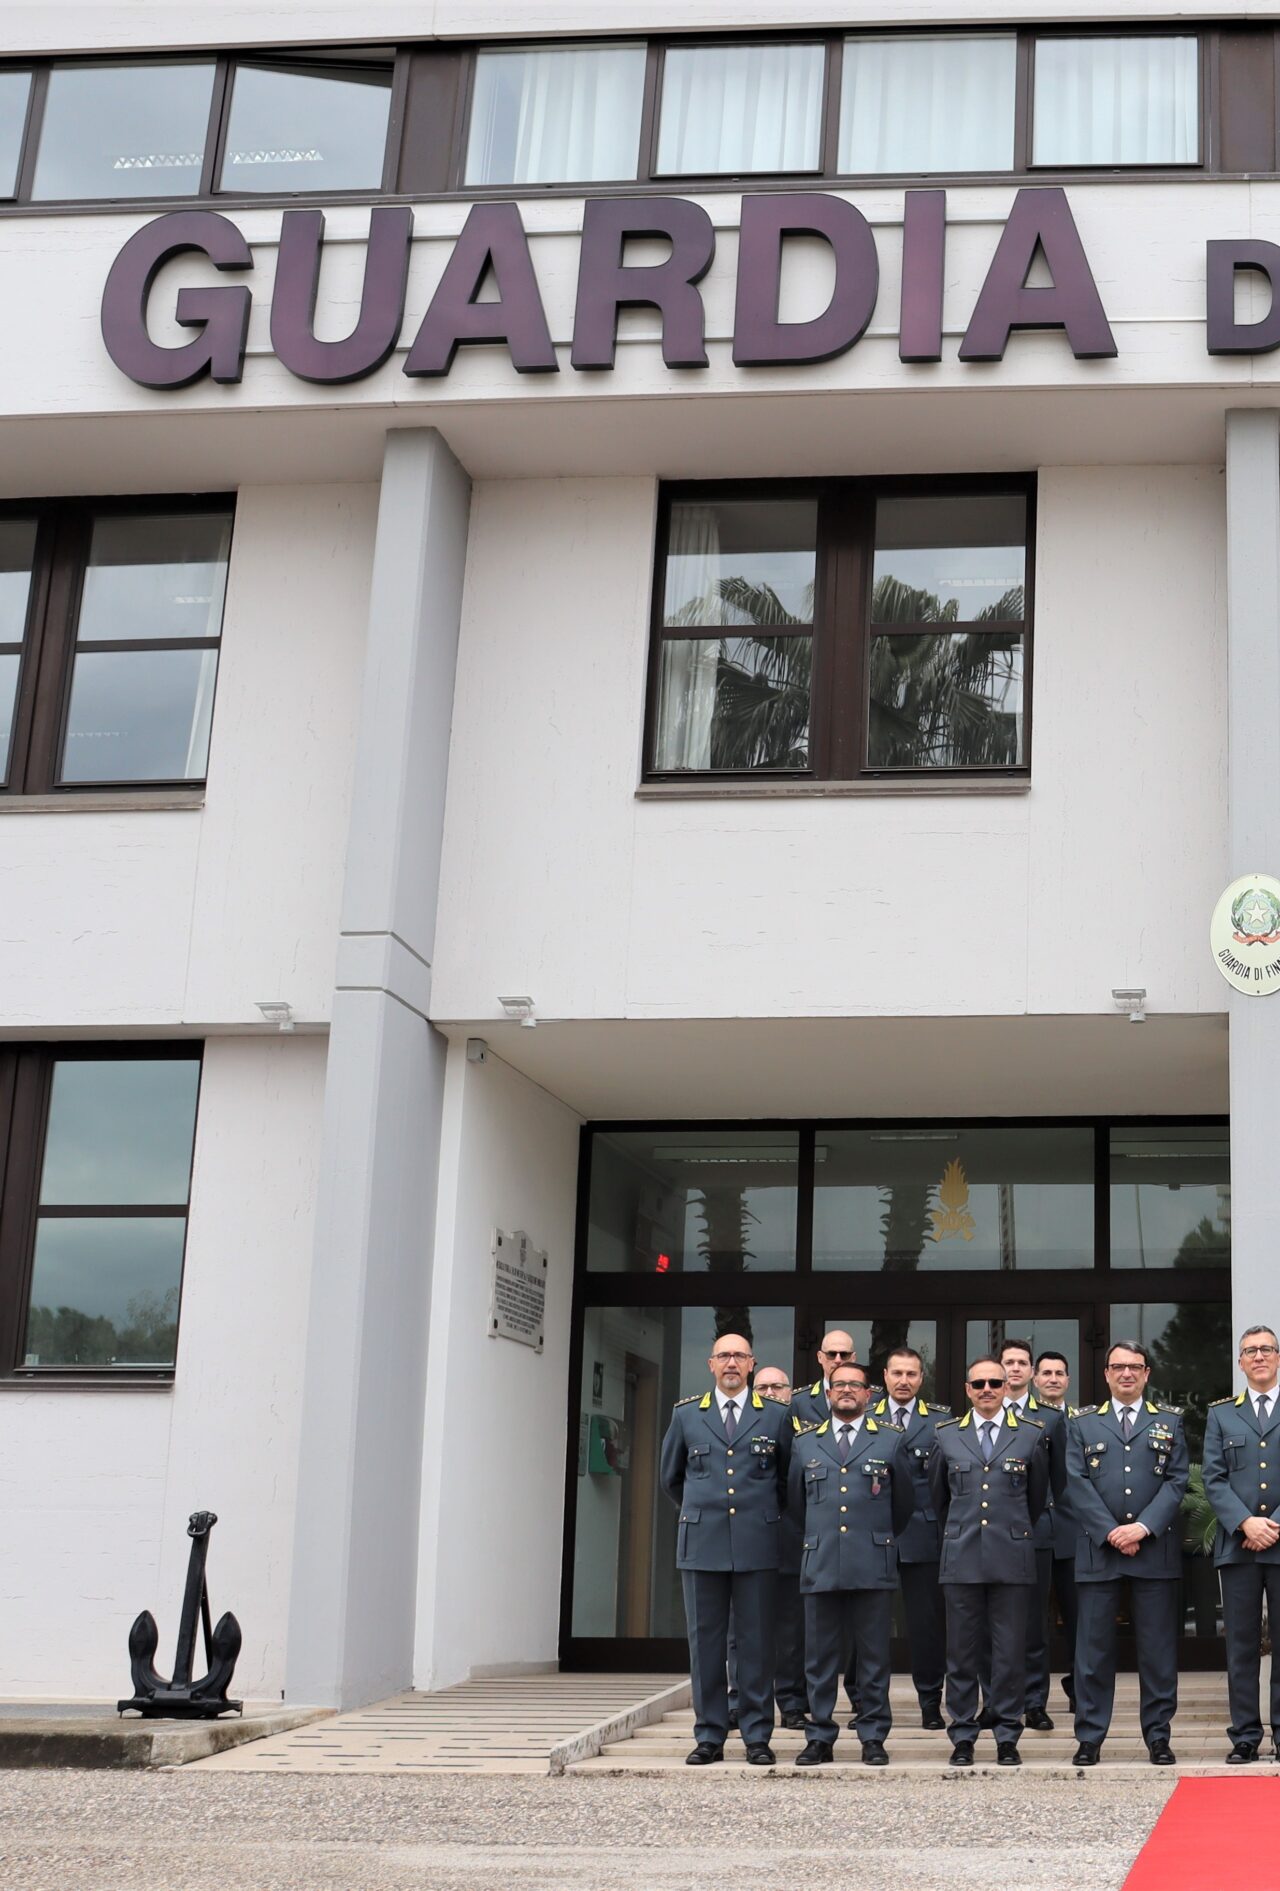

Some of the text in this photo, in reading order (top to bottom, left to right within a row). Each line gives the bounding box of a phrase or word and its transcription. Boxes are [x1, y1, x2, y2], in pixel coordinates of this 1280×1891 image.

[101, 187, 1118, 390] GUARDIA
[1218, 948, 1251, 979] GUARDIA
[1254, 967, 1263, 981] DI
